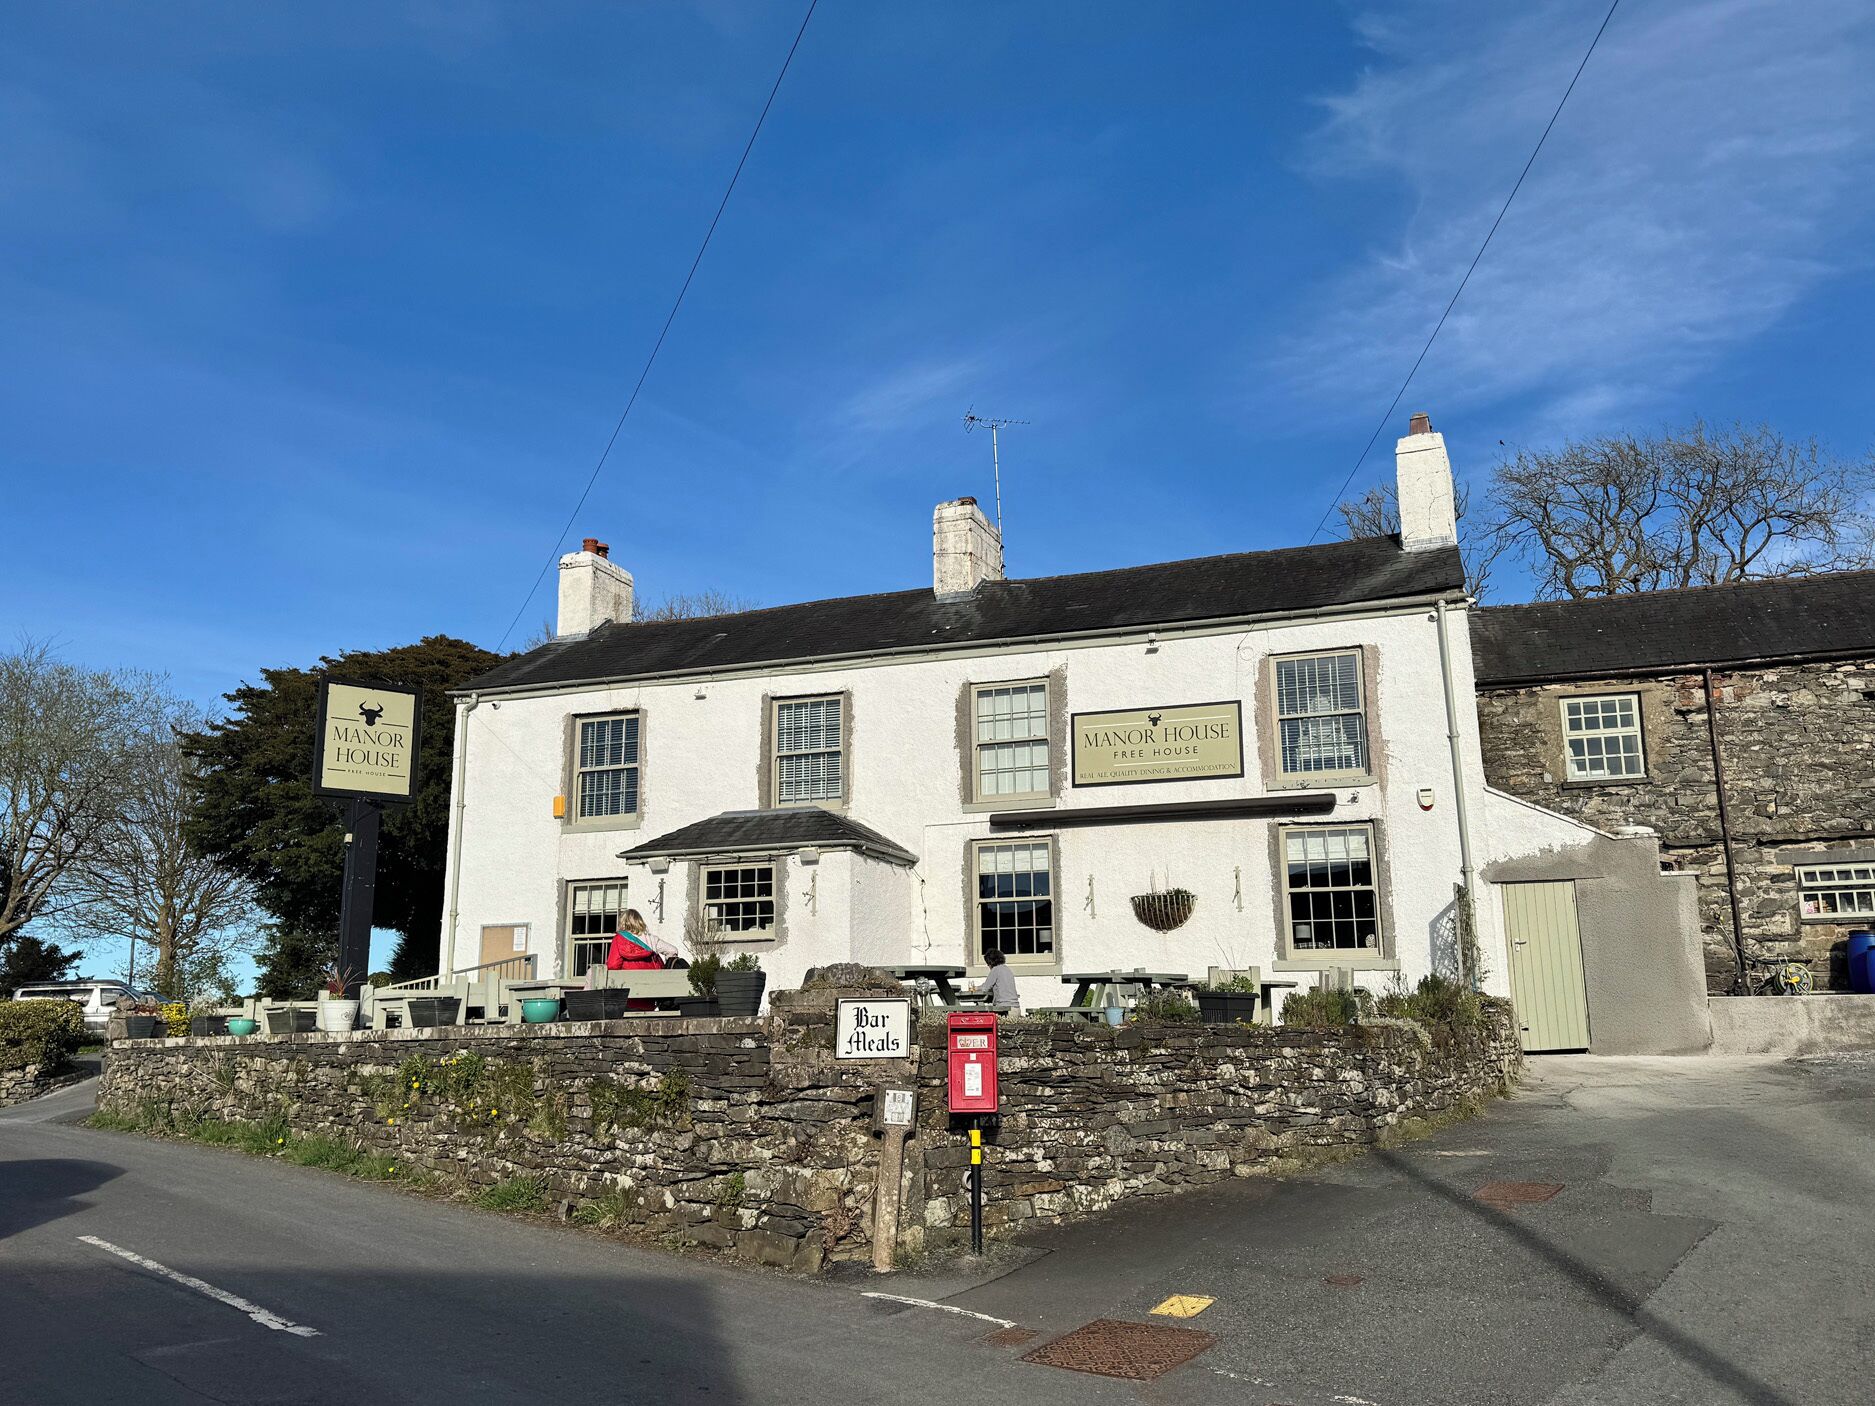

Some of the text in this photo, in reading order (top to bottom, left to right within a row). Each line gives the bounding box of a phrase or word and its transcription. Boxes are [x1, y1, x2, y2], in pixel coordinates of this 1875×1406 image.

[333, 726, 404, 748] MANOR
[1084, 722, 1230, 748] MANOR HOUSE
[336, 747, 399, 768] HOUSE
[1113, 745, 1198, 759] FREE HOUSE
[1110, 769, 1138, 777] QUALITY
[1174, 763, 1236, 773] ACCOMMODATION
[853, 1006, 889, 1030] Bar
[845, 1031, 899, 1054] Meals
